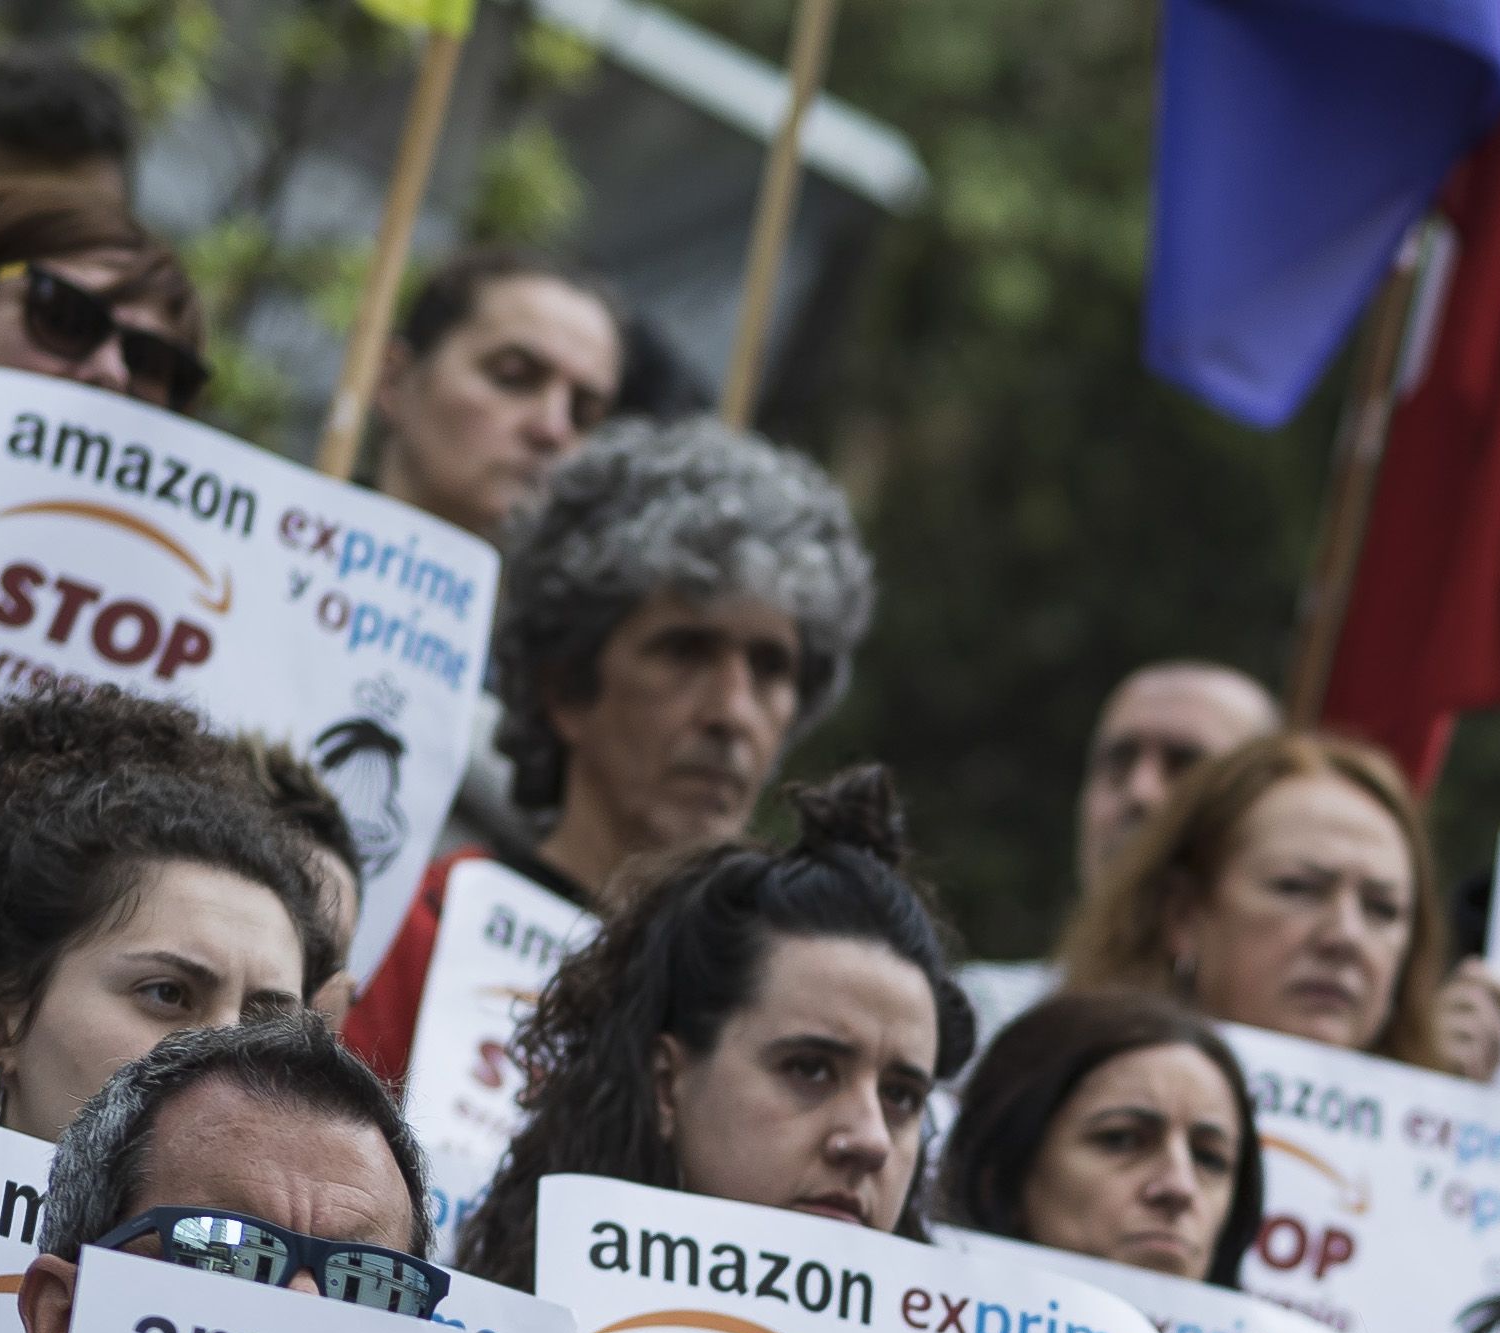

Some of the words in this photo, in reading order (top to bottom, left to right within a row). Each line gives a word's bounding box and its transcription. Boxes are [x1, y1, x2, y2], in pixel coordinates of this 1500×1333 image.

[7, 412, 259, 532] amazon
[281, 510, 477, 614] exprime
[317, 588, 469, 688] oprime
[1250, 1070, 1384, 1139] azon
[588, 1219, 874, 1321] amazon
[1257, 1213, 1356, 1280] OP
